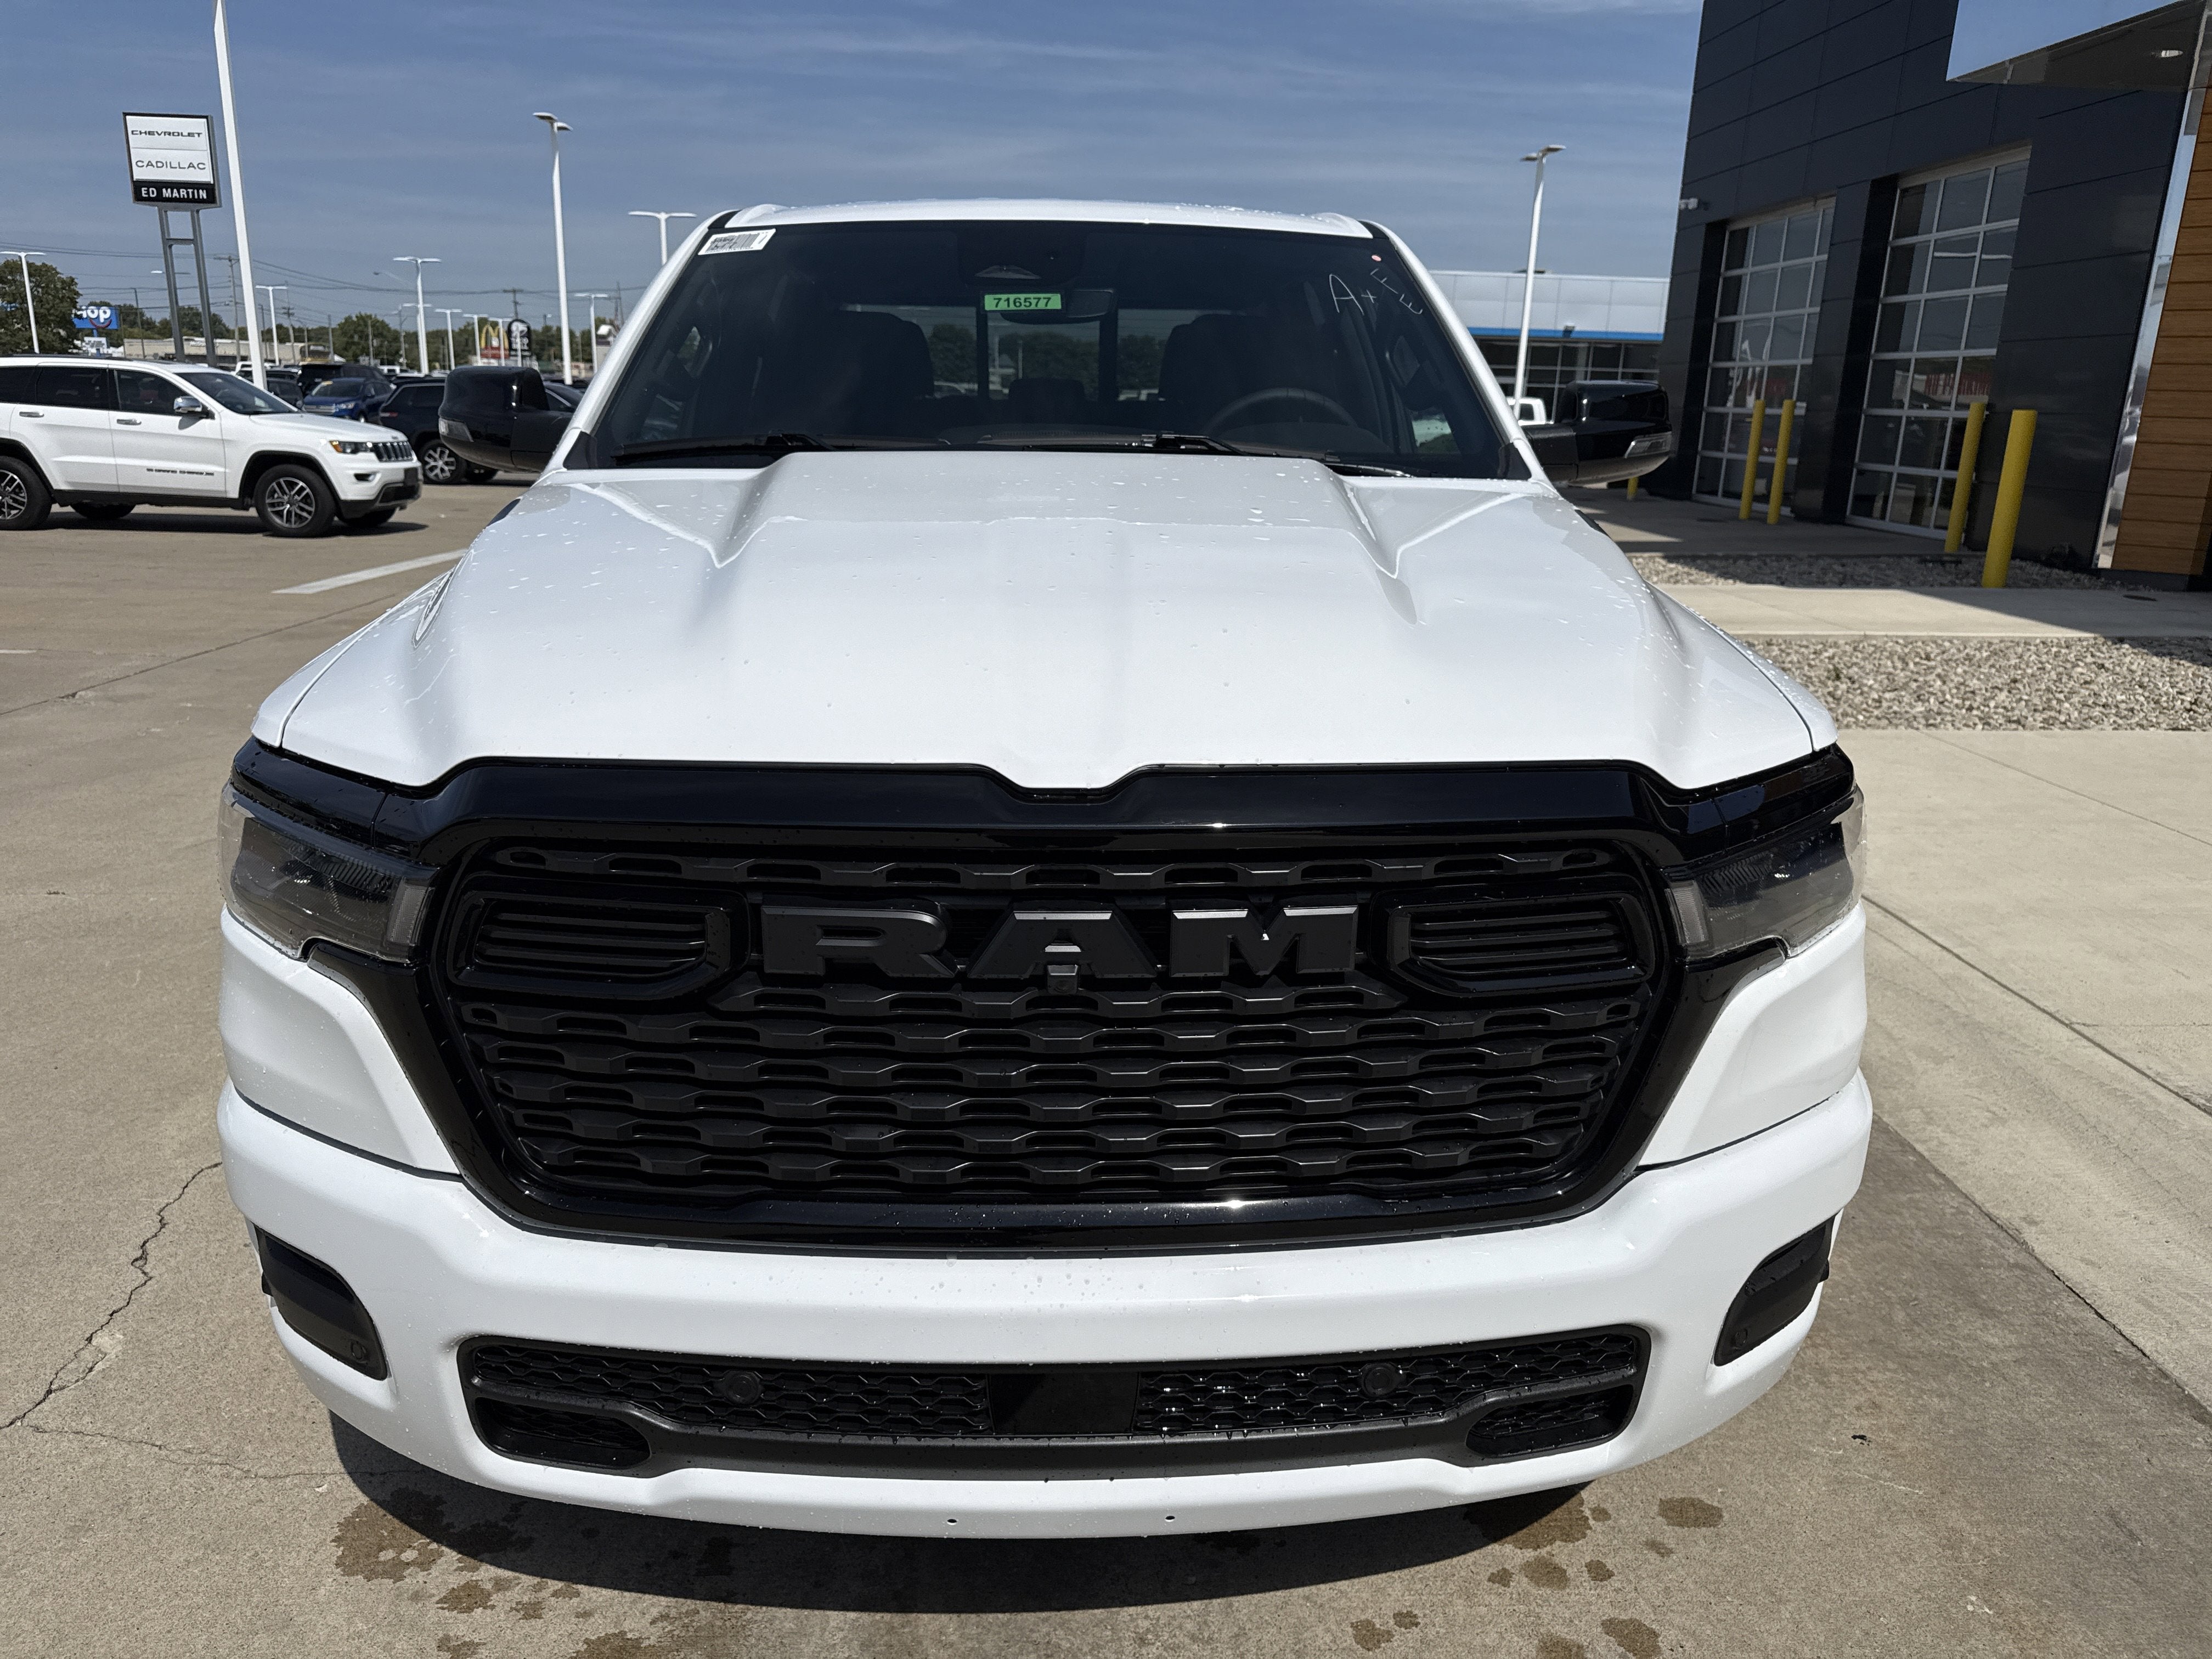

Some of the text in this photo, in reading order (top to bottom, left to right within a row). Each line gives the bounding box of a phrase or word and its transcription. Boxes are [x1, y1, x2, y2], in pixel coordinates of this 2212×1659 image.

[131, 129, 202, 138] CHEVROLET
[135, 160, 206, 170] CADILLAC
[141, 187, 207, 199] ED MARTIN
[993, 297, 1052, 308] 716577
[761, 905, 1358, 979] RAM
